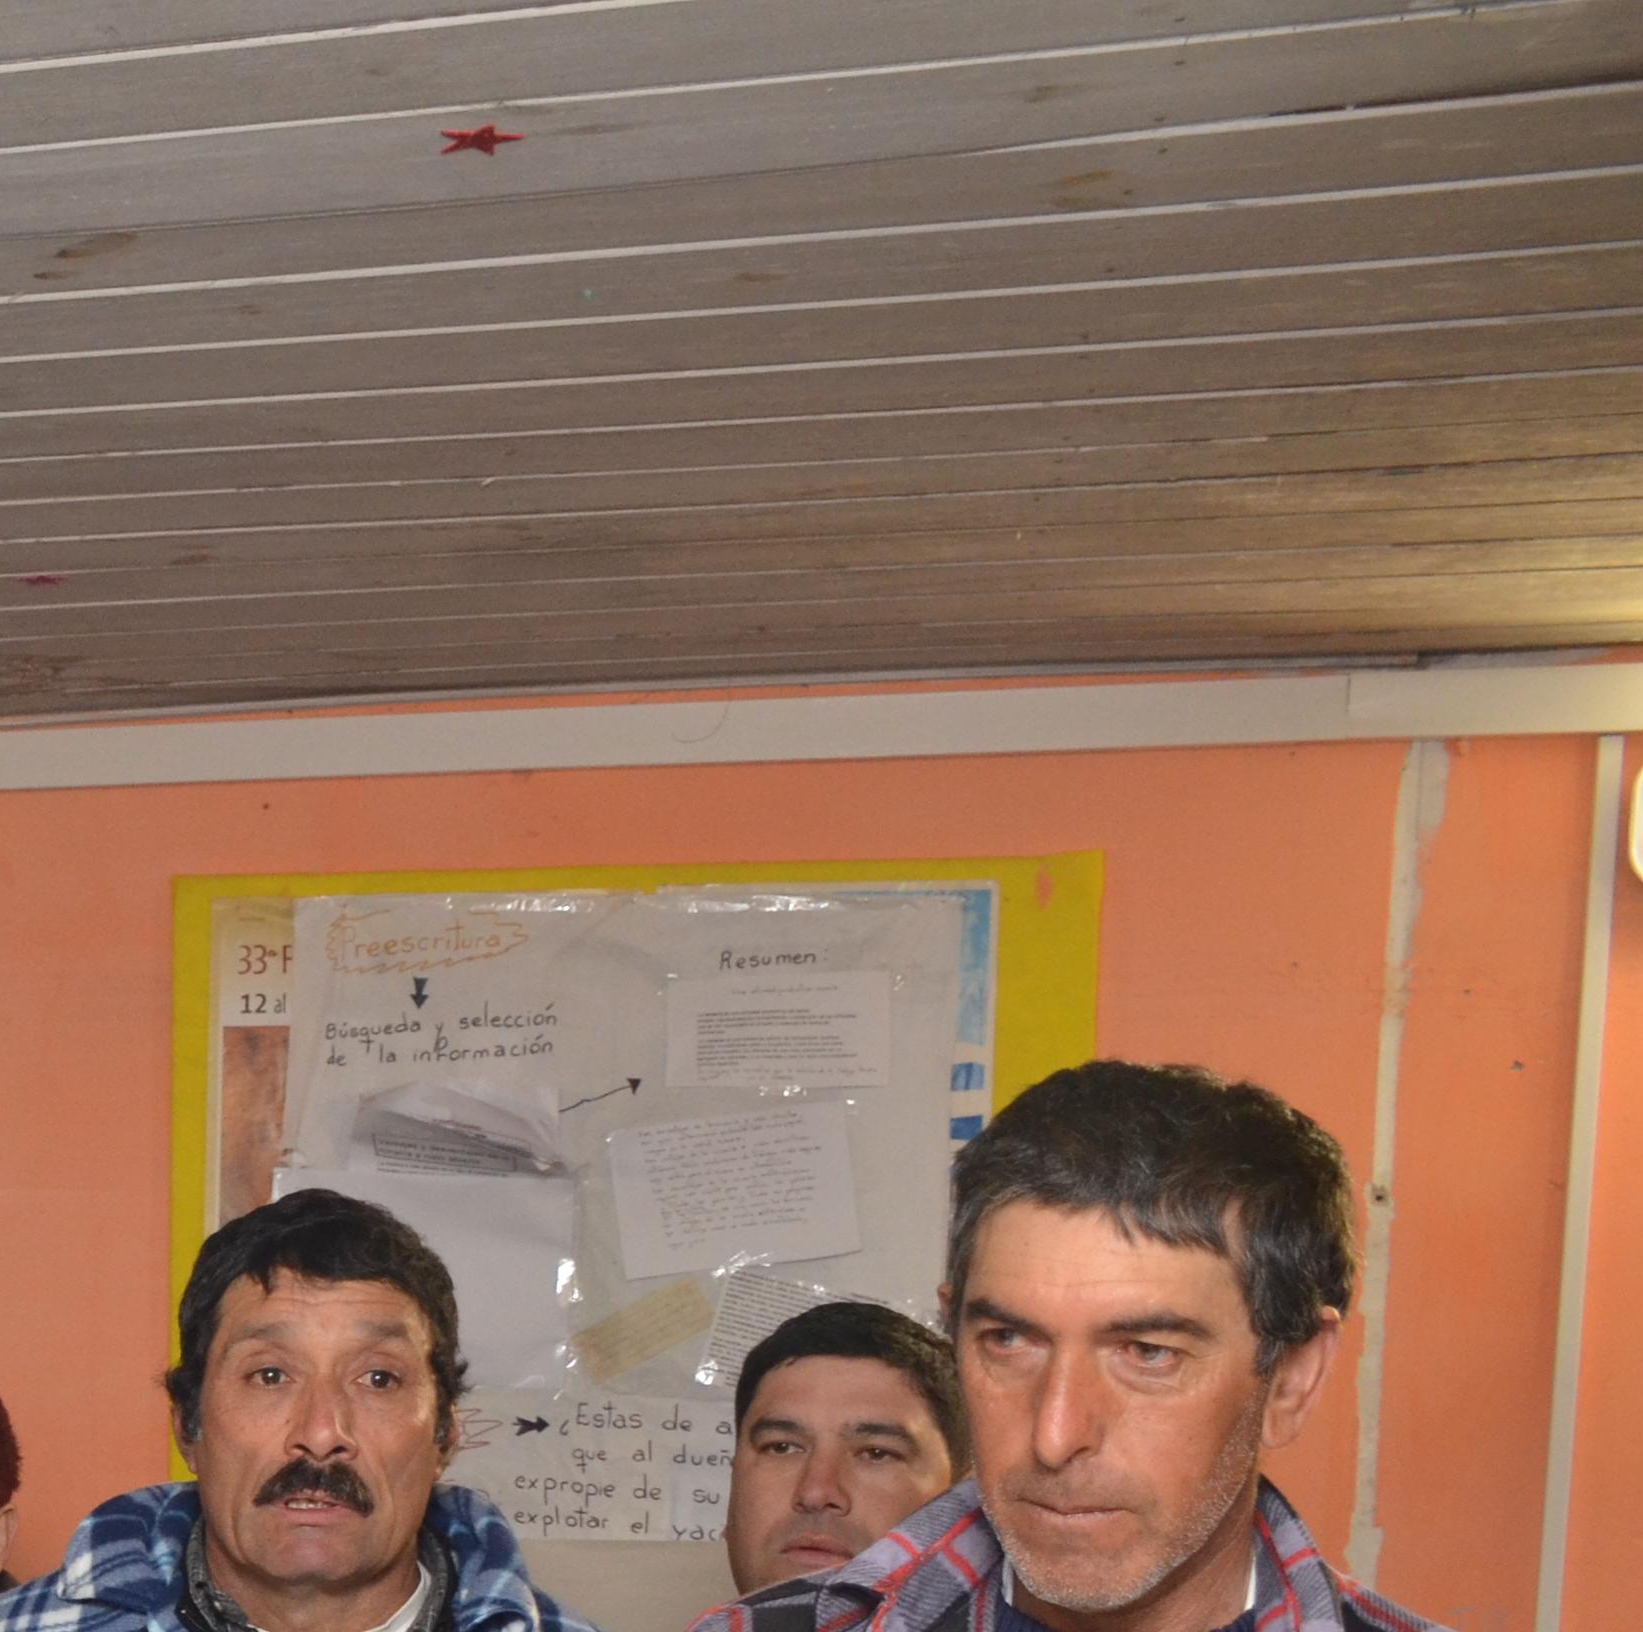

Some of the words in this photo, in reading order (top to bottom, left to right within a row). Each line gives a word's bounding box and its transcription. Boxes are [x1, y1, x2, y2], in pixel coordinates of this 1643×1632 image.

[341, 919, 502, 963] Preescritura
[239, 993, 267, 1015] 12
[458, 1001, 558, 1031] selección
[327, 1046, 347, 1068] de
[379, 1046, 397, 1065] la
[661, 1404, 692, 1432] de
[572, 1448, 608, 1474] que
[632, 1440, 652, 1462] al
[514, 1473, 616, 1508] expropie
[633, 1473, 662, 1501] de
[514, 1506, 610, 1537] explotar
[630, 1512, 650, 1535] el
